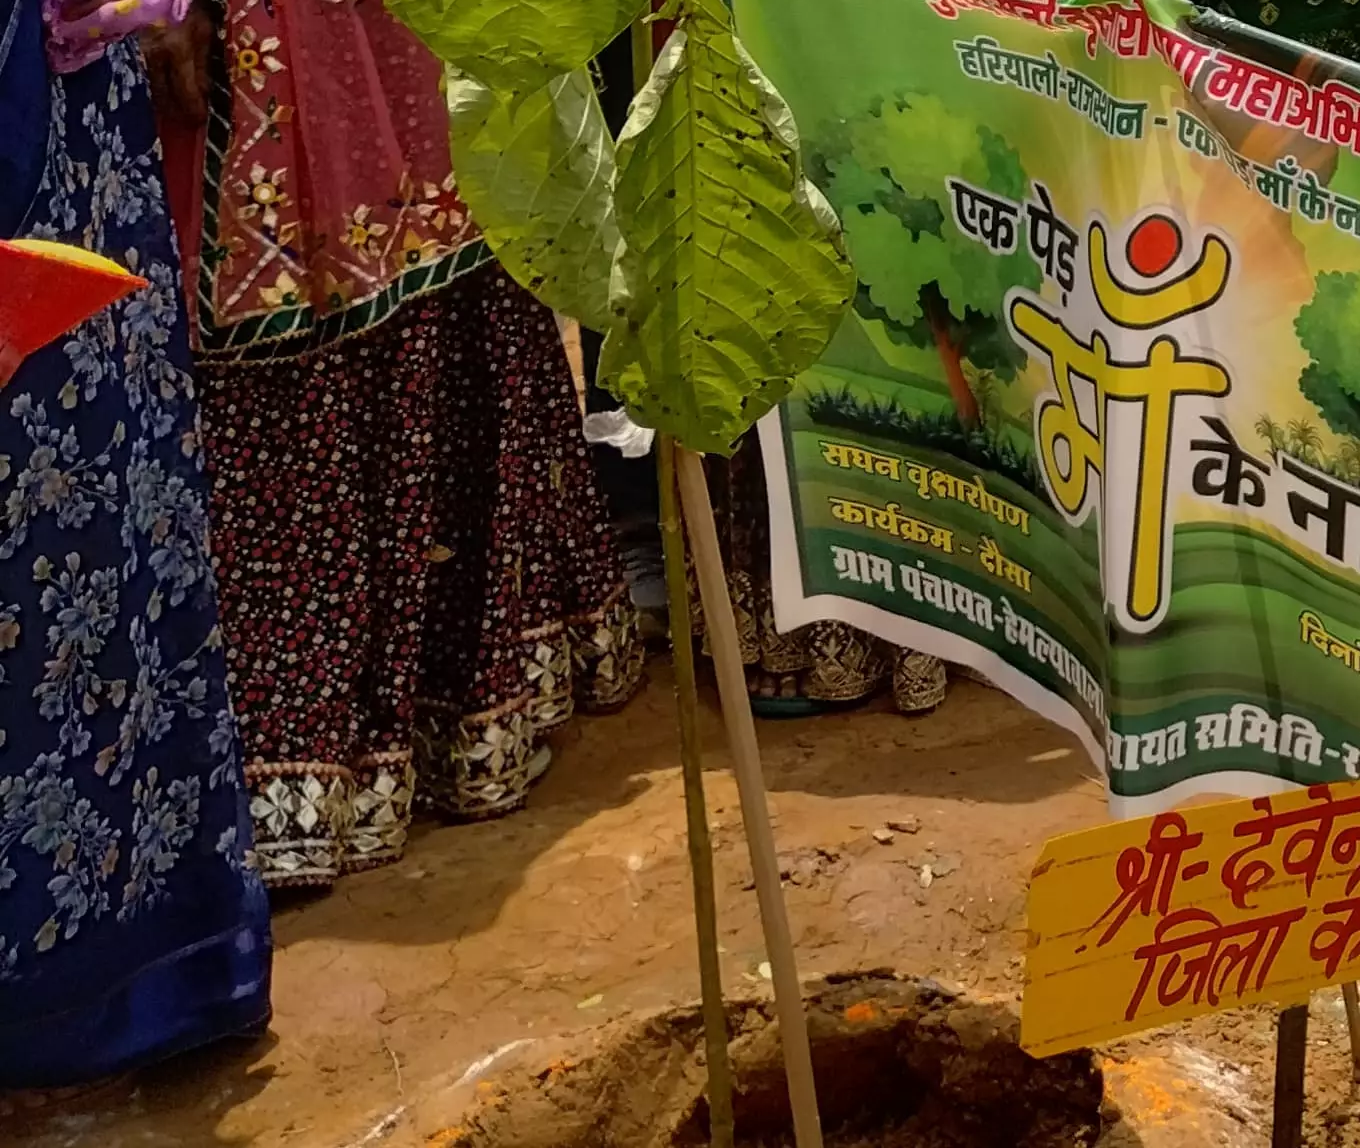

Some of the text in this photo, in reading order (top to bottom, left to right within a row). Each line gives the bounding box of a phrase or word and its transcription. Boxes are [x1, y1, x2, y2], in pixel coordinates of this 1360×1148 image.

[1175, 107, 1220, 161] एक
[1251, 157, 1297, 213] माँ
[1297, 171, 1332, 223] के
[948, 178, 1020, 252] एक
[1026, 180, 1080, 309] पेड़
[1188, 413, 1273, 509] के
[818, 440, 1031, 536] सघन वृक्षारोपण
[827, 496, 955, 554] कार्यक्रम
[978, 533, 1033, 594] दौसा
[829, 544, 896, 593] ग्राम
[1134, 907, 1308, 1022] जिला
